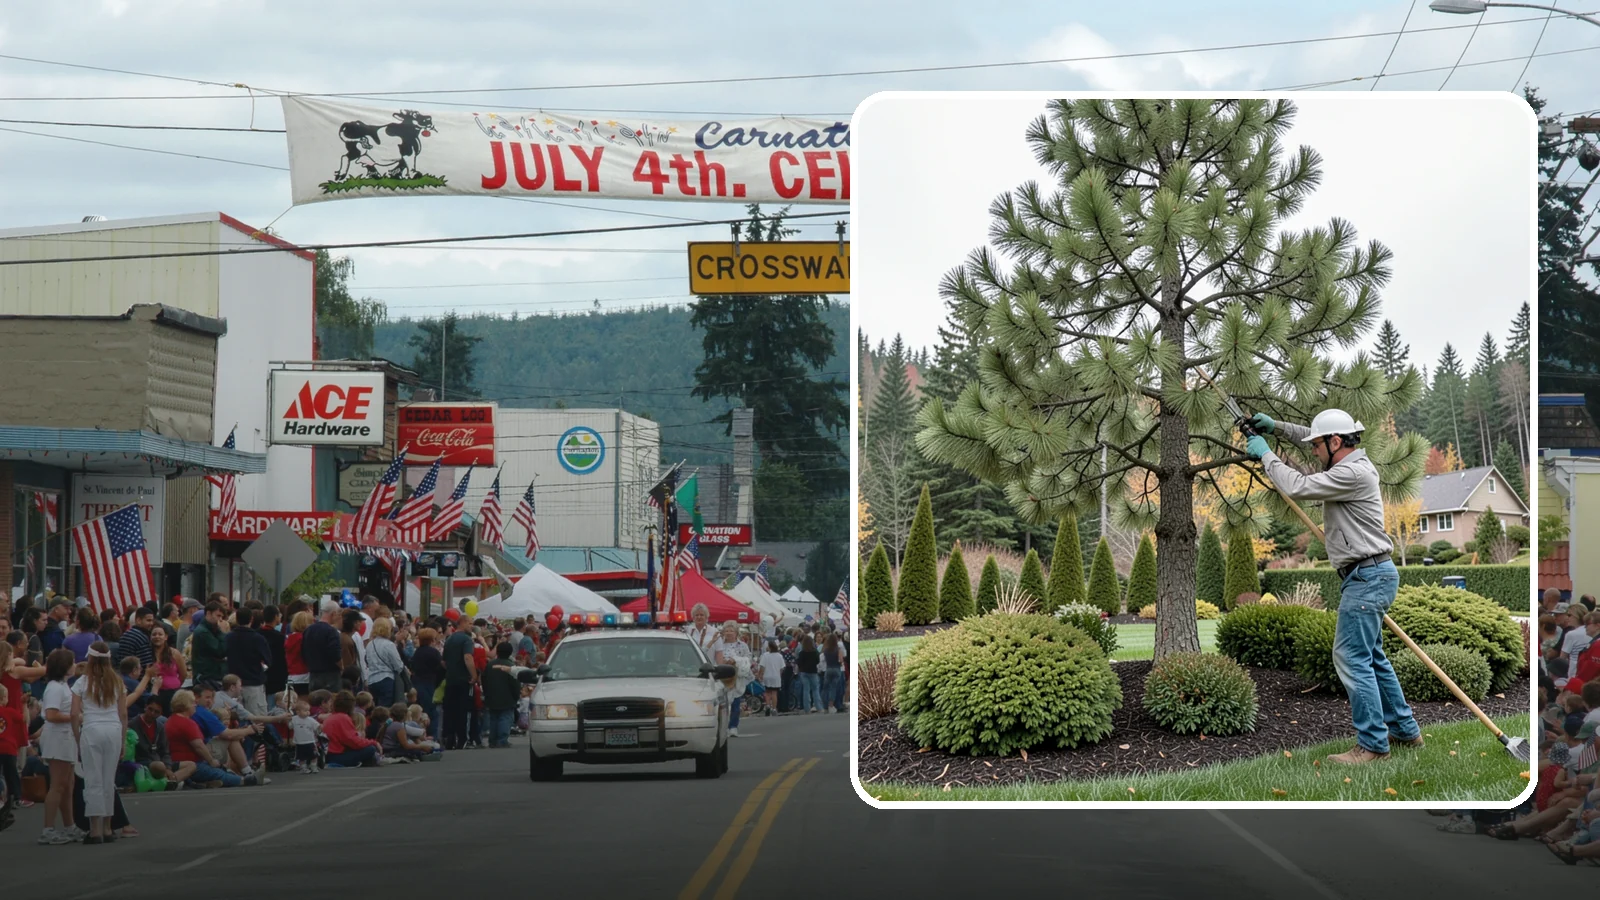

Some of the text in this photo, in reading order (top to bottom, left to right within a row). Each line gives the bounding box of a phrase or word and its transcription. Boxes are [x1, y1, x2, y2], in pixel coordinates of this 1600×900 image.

[695, 122, 850, 149] Carnat
[481, 141, 604, 192] JULY
[633, 150, 746, 197] 4th.
[697, 254, 850, 279] CROSSWA
[283, 380, 373, 419] ACE
[406, 409, 452, 421] CEDAR
[284, 421, 371, 436] Hardware
[83, 485, 155, 495] St. Vincent de Paul
[212, 516, 330, 535] HARDARE
[700, 535, 730, 543] GLASS
